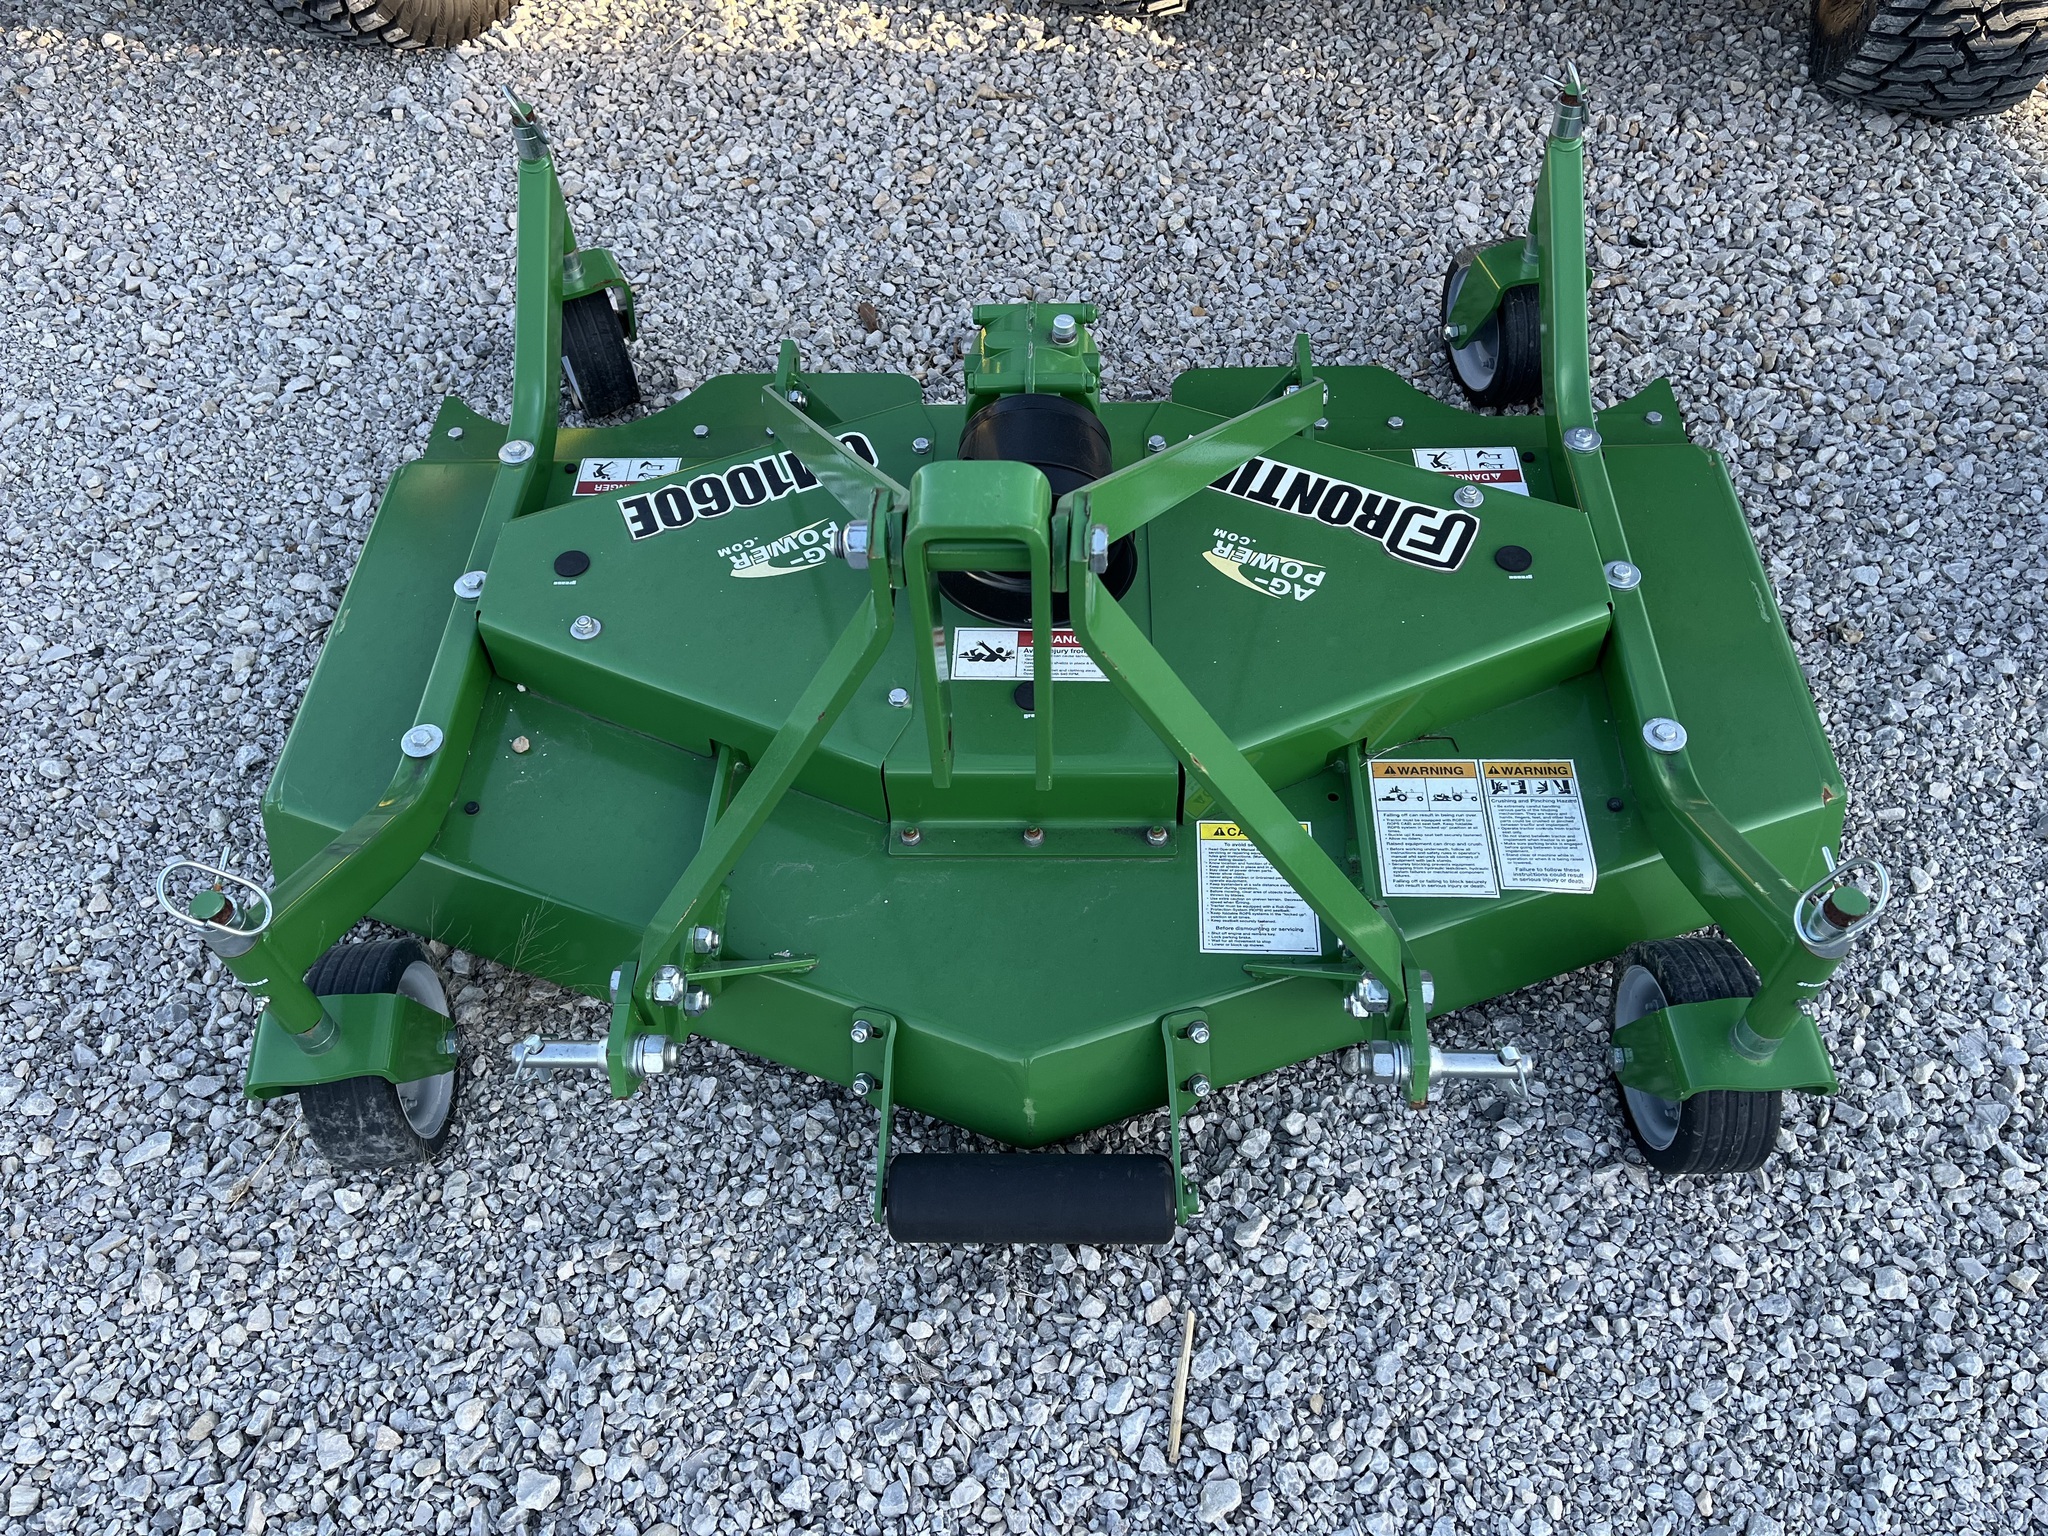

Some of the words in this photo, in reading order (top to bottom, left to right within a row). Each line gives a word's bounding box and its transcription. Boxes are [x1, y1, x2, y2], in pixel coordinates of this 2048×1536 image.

[1213, 528, 1256, 545] .COM
[1212, 540, 1326, 587] POWER
[1254, 577, 1316, 602] AG-
[1397, 766, 1464, 775] WARNING
[1500, 766, 1568, 775] WARNING
